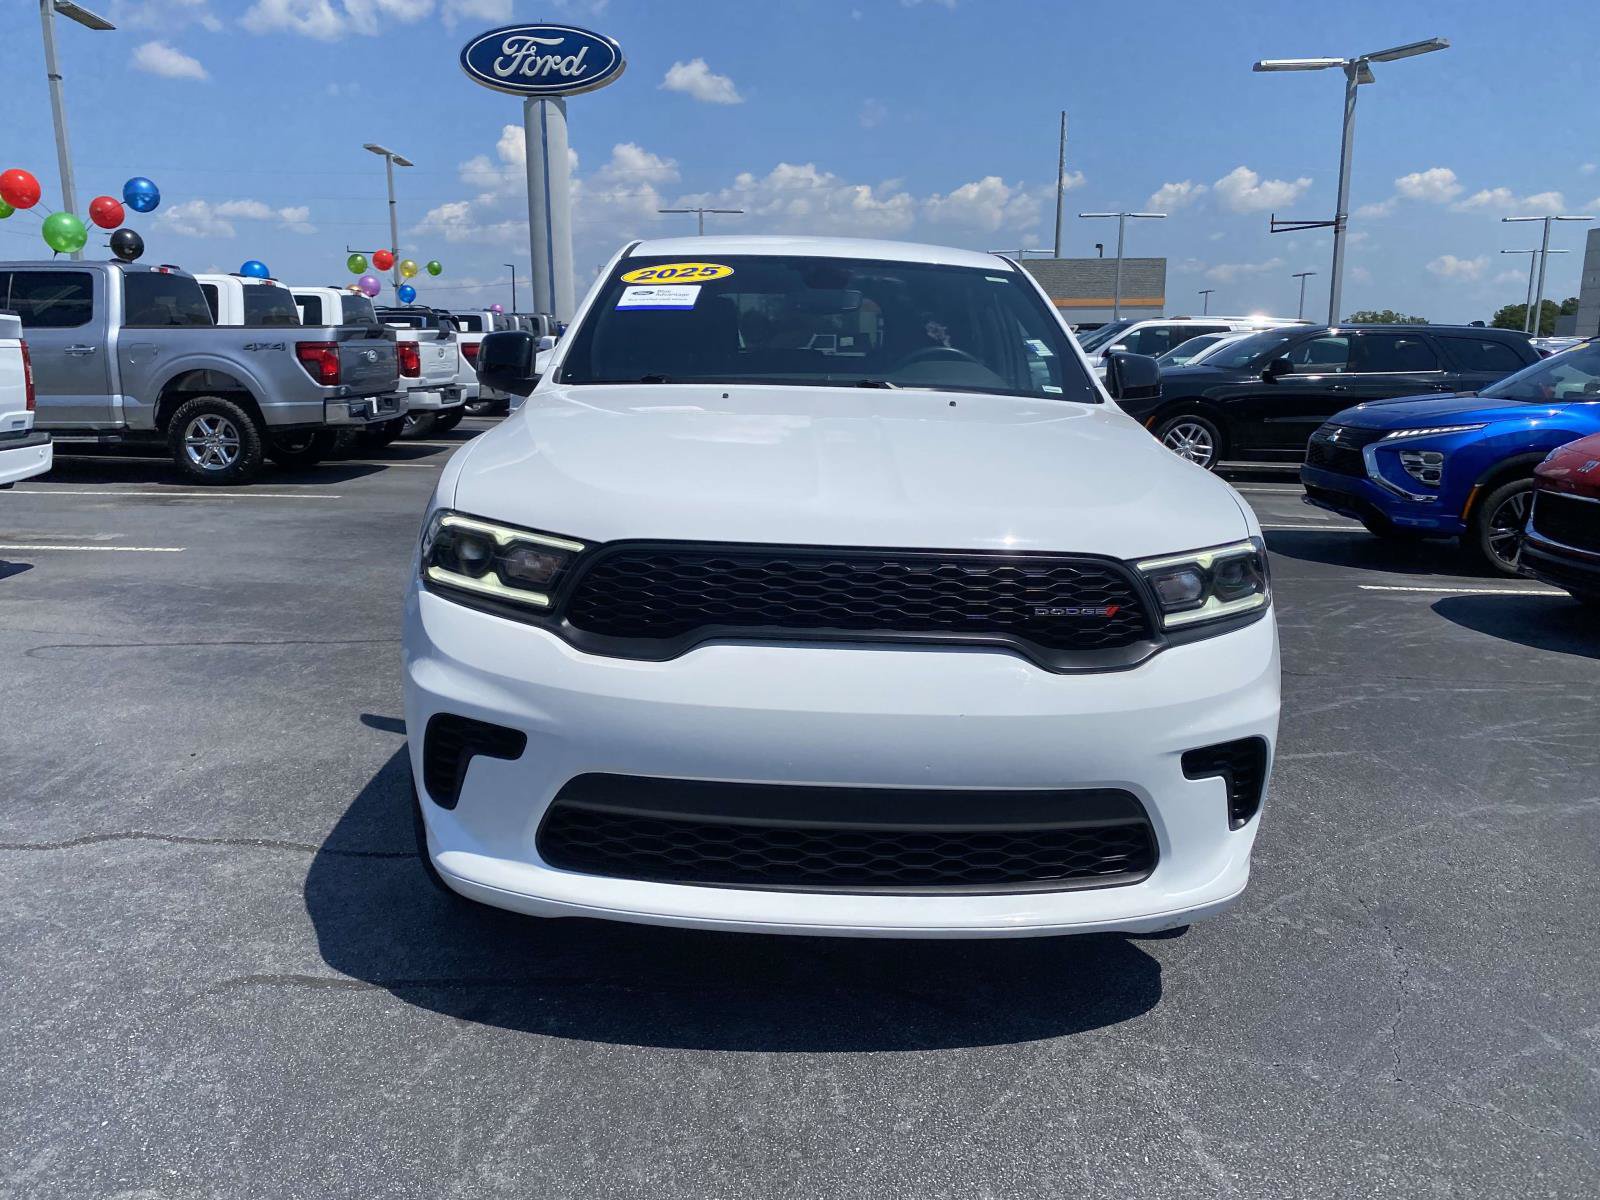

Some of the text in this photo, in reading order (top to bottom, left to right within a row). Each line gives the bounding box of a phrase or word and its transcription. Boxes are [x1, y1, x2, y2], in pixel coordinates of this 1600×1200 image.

[493, 35, 590, 78] Ford
[633, 266, 721, 281] 2025
[1034, 608, 1107, 616] DODGE
